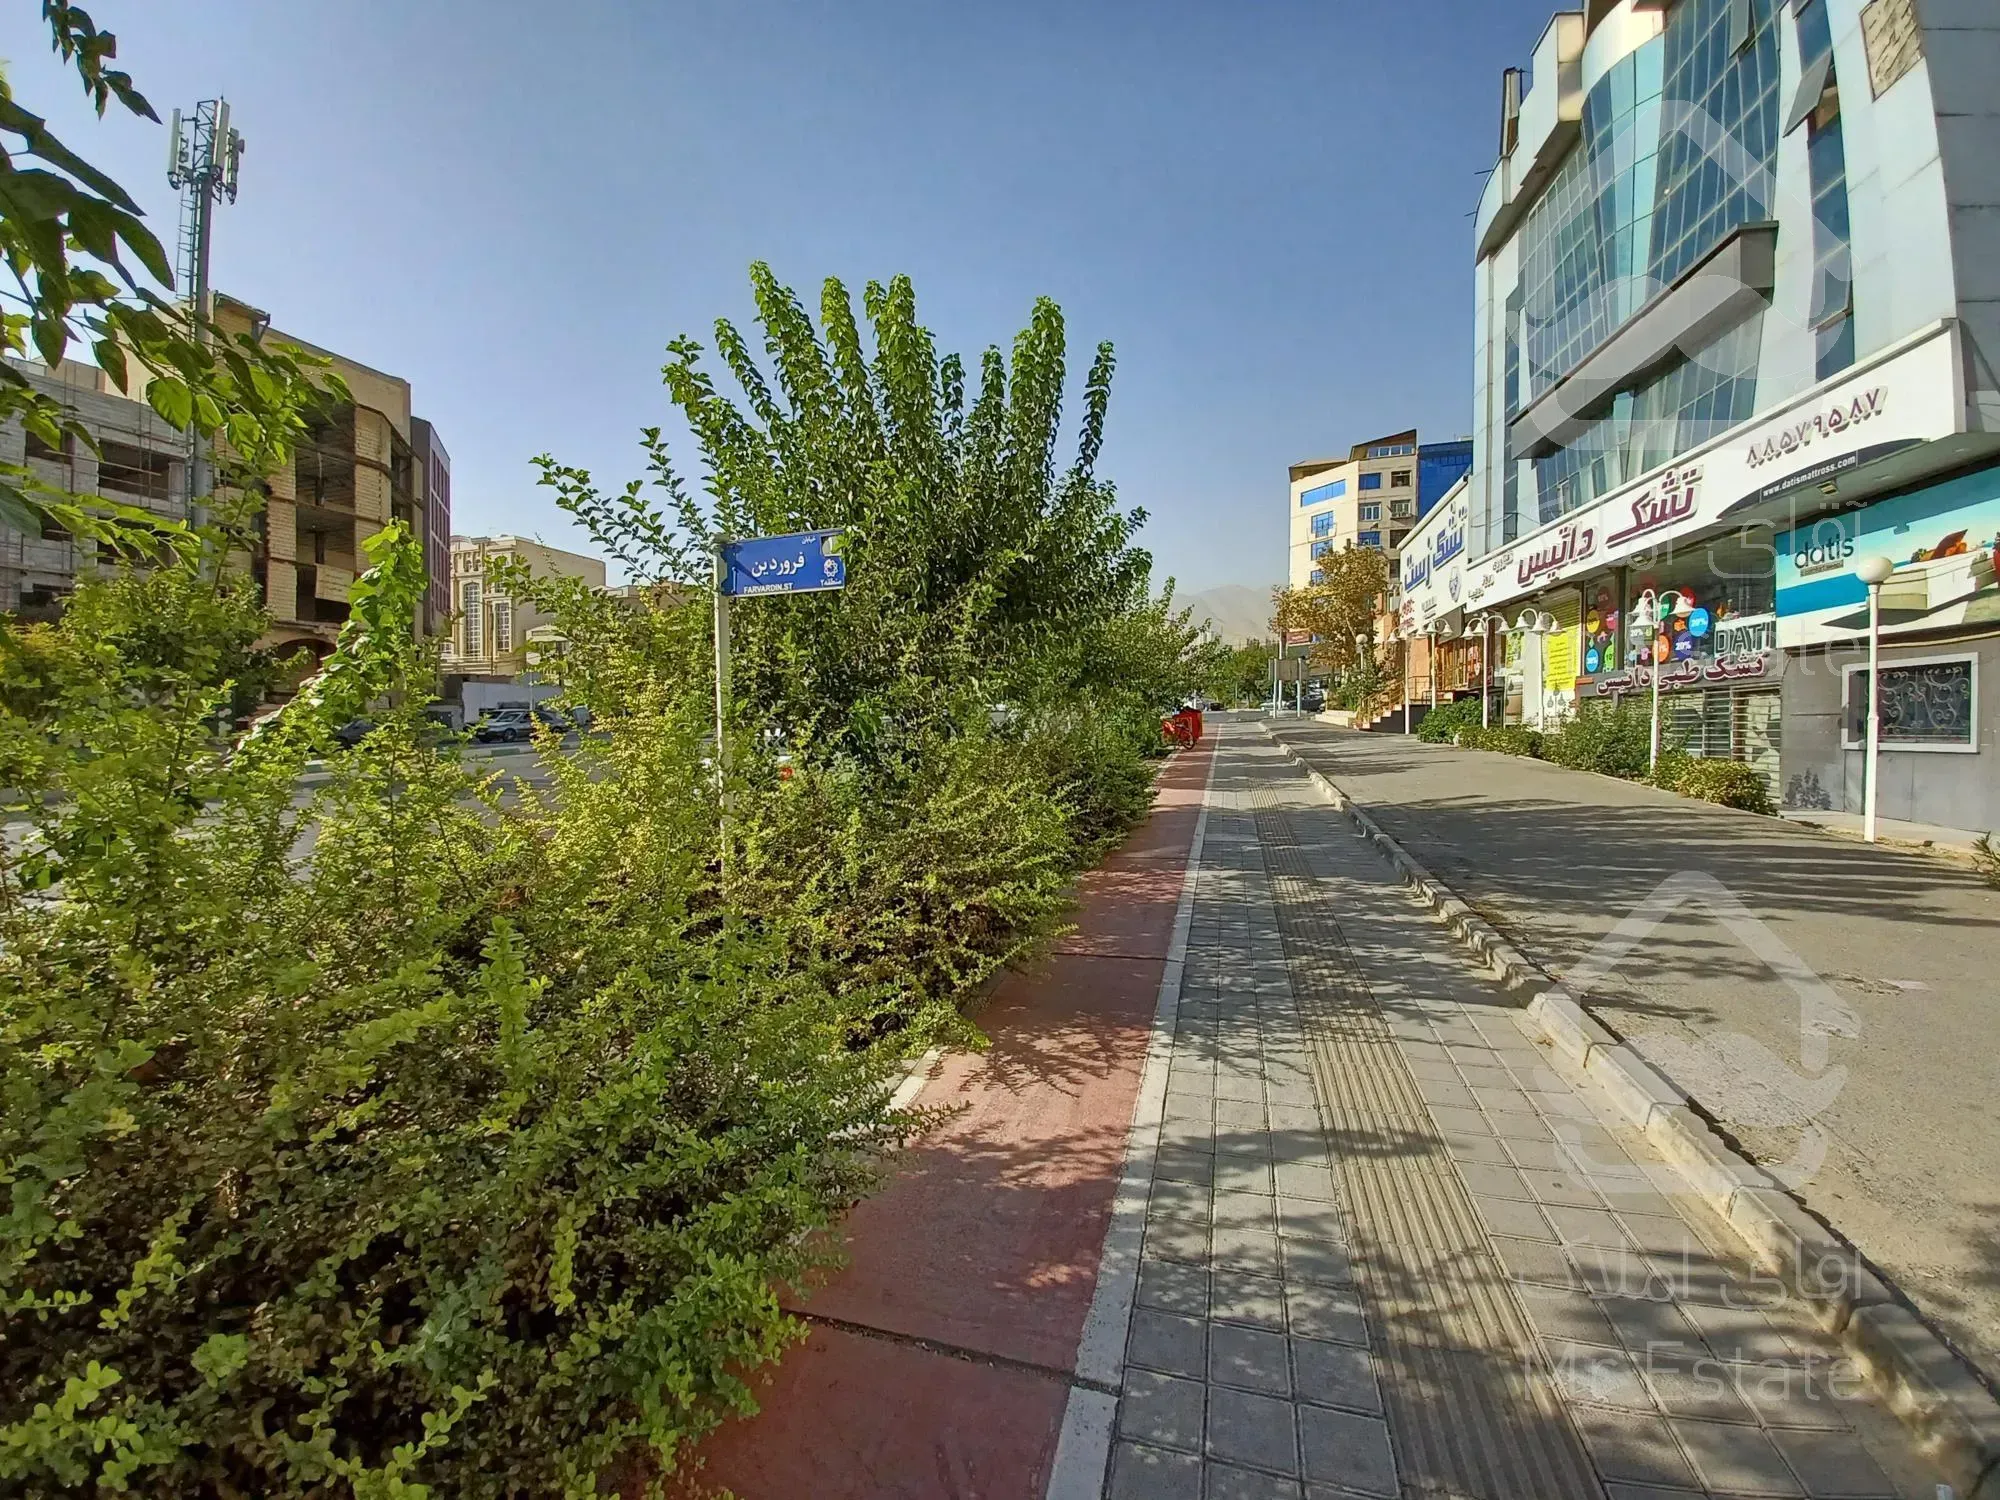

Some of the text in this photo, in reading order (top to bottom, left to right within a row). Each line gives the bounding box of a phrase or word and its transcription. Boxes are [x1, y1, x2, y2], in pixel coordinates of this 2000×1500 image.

[1746, 386, 1886, 468] ۸۸۵۷۹۵۸۷
[1762, 456, 1856, 498] www.datismattross.com
[1433, 501, 1468, 569] تشک
[1517, 468, 1700, 585] تشک داتیس
[752, 551, 806, 578] فروردین
[1795, 534, 1854, 568] datis
[743, 582, 794, 595] FARVARDIN.ST
[1675, 640, 1692, 651] 20%
[1597, 663, 1650, 697] داتیس
[1656, 657, 1700, 691] طبی
[1704, 651, 1769, 681] تشک
